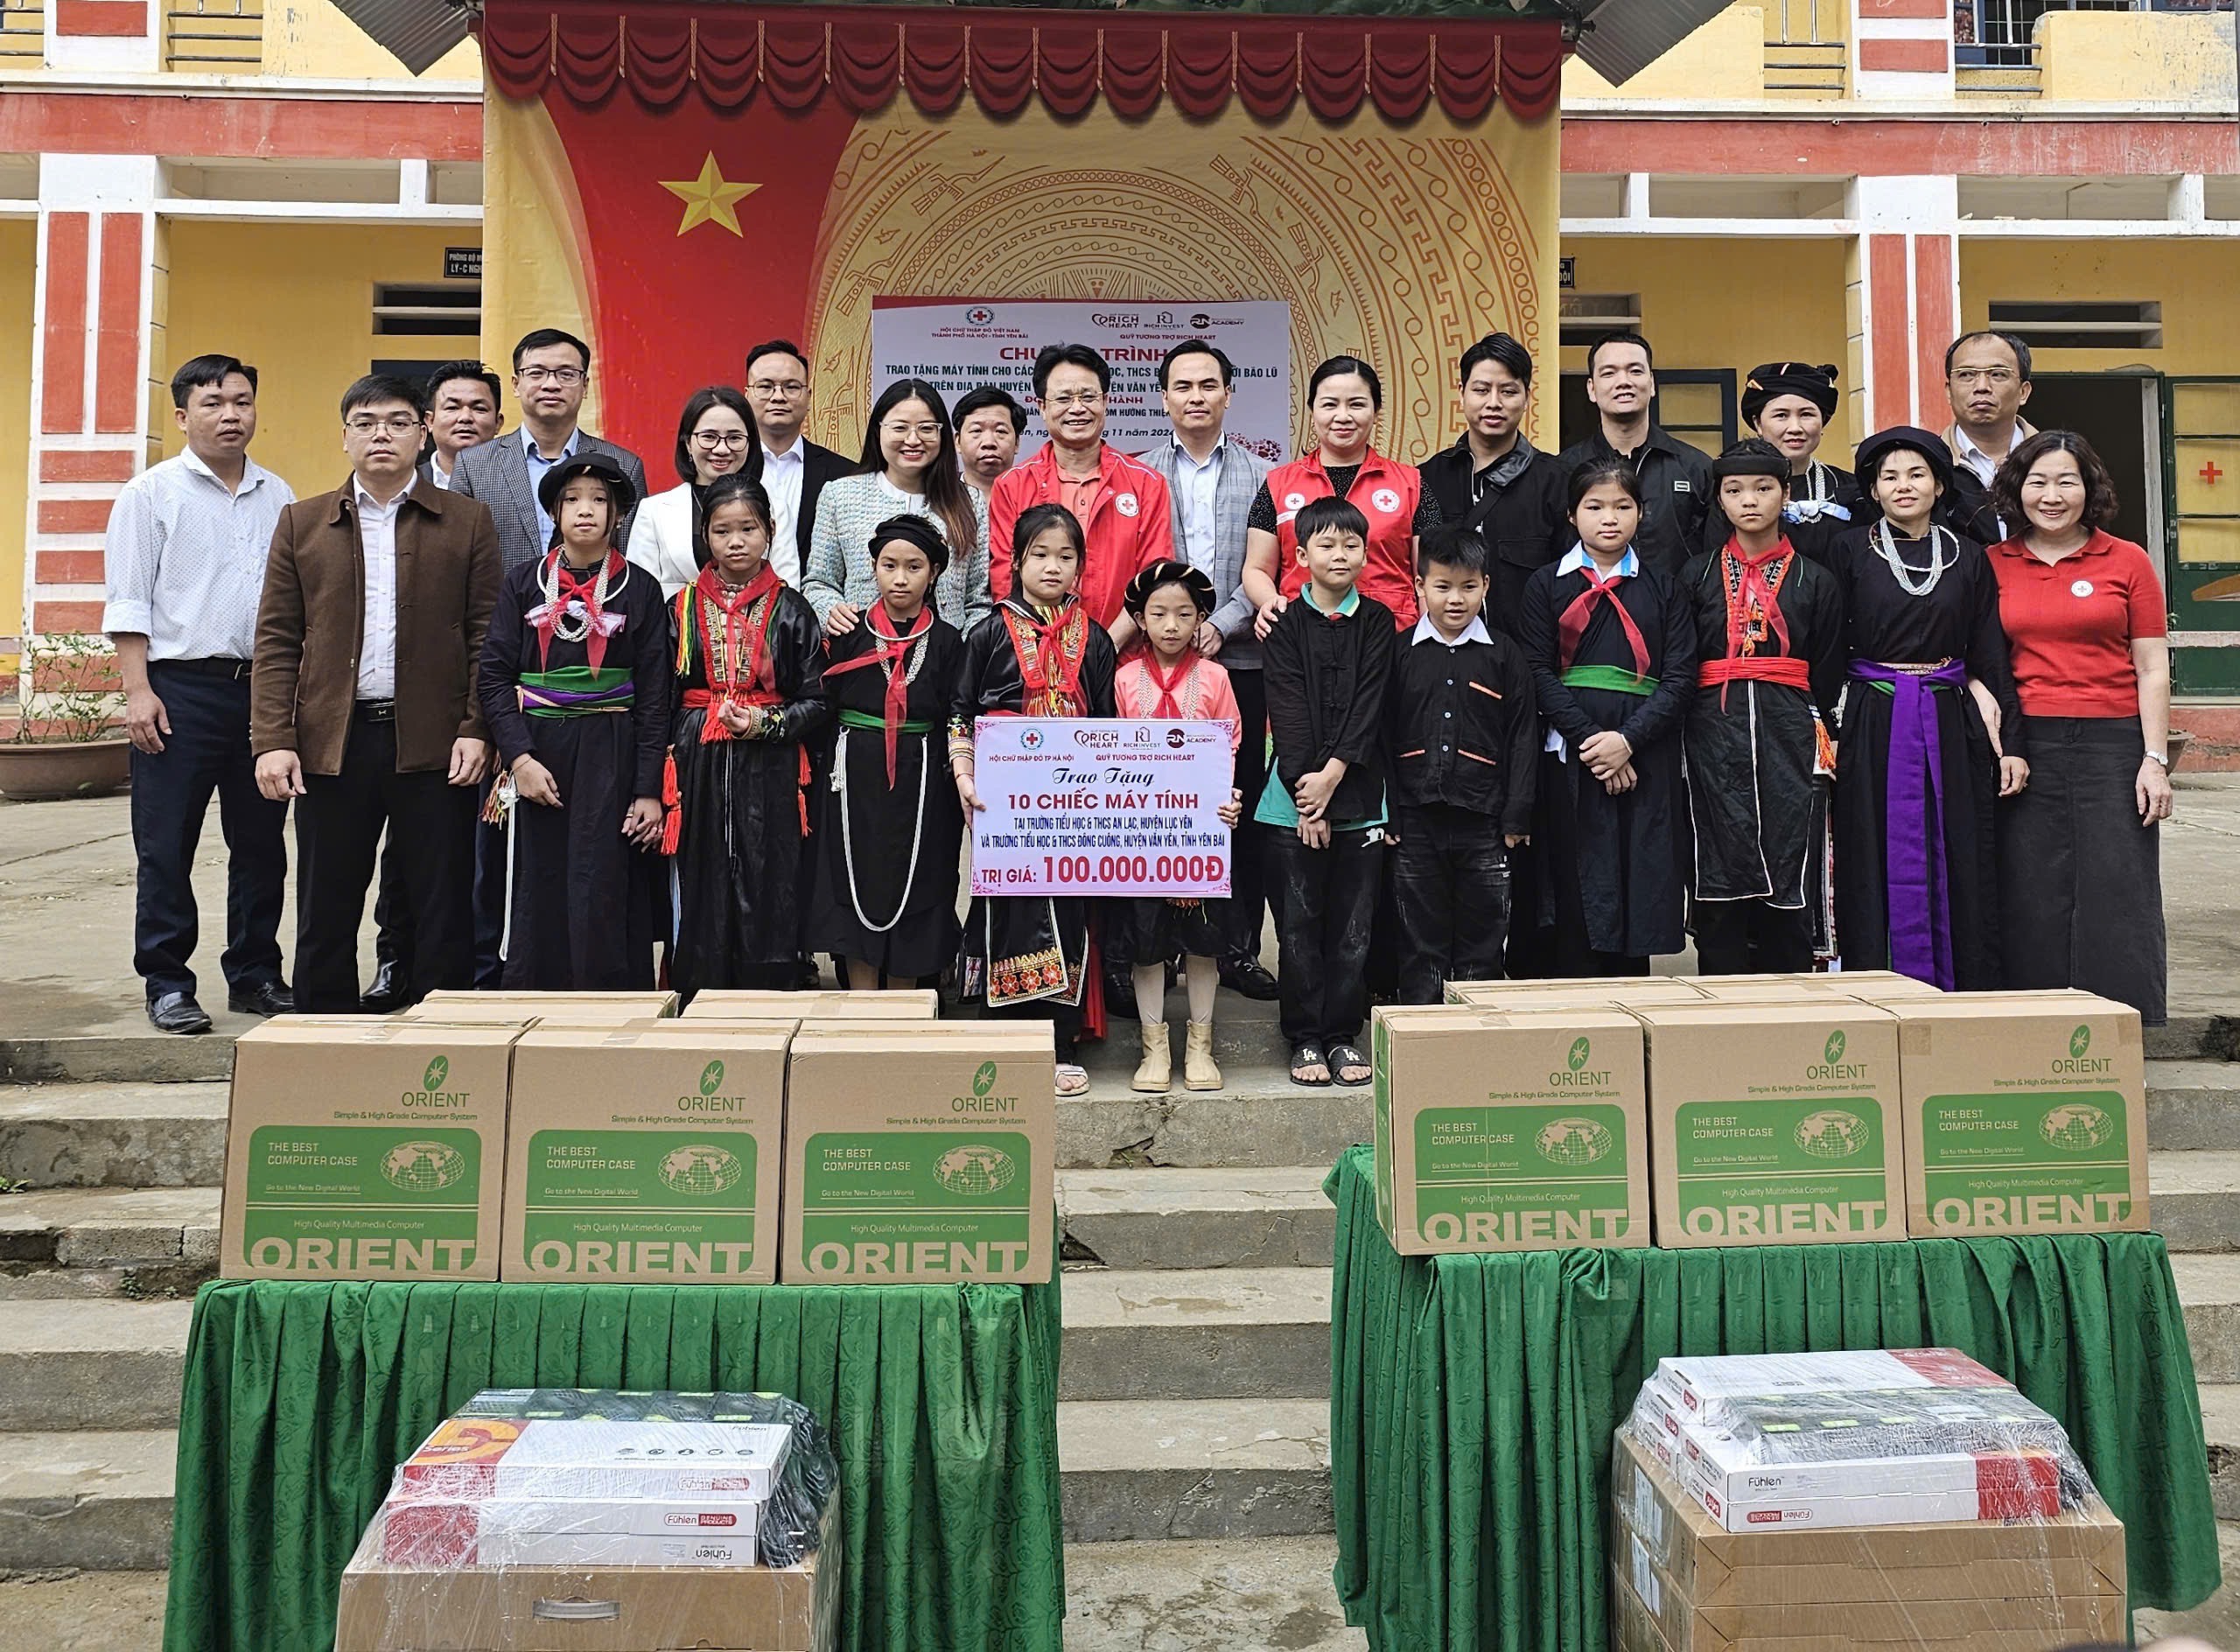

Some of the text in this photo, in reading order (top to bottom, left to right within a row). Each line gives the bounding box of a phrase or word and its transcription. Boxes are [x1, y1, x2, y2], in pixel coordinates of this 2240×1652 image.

[1100, 345, 1168, 361] TRÌNH
[886, 365, 910, 374] TRAO
[914, 364, 939, 377] TẶNG
[942, 364, 963, 375] MÁY
[966, 364, 989, 375] TÍNH
[991, 366, 1012, 375] CHO
[1015, 364, 1034, 376] CÁC
[1127, 367, 1152, 377] THCS
[1244, 366, 1264, 378] BÃO
[1266, 366, 1278, 378] LŨ
[956, 381, 973, 393] ĐỊA
[999, 381, 1031, 394] HUYỆN
[1127, 382, 1146, 392] VĂN
[1109, 395, 1143, 404] HÀNH
[1090, 732, 1119, 741] RICH
[1053, 767, 1154, 787] Trao Tặng
[1008, 787, 1199, 809] 10 CHIẾC MÁY TÍNH
[1014, 817, 1026, 832] TẠI
[1027, 815, 1054, 830] TRƯỜNG
[1073, 816, 1086, 831] HỌC
[1087, 817, 1092, 830] &
[1094, 817, 1111, 830] THCS
[1113, 817, 1123, 830] AN
[1140, 815, 1164, 831] HUYỆN
[1165, 816, 1178, 831] LỤC
[1179, 815, 1193, 830] YÊN
[981, 833, 990, 847] VÀ
[992, 833, 1018, 848] TRƯỜNG
[1037, 835, 1050, 850] HỌC
[1052, 836, 1057, 847] &
[1058, 836, 1076, 847] THCS
[1124, 832, 1147, 850] HUYỆN
[1198, 832, 1212, 847] YÊN
[1214, 832, 1225, 847] BÁI
[981, 855, 1224, 887] TRỊ GIÁ: 100.000.000Đ
[1302, 1047, 1318, 1062] LA
[1342, 1047, 1361, 1062] LA
[1806, 1063, 1867, 1080] ORIENT
[2051, 1058, 2112, 1074] ORIENT
[1549, 1071, 1612, 1086] ORIENT
[402, 1091, 471, 1108] ORIENT
[677, 1096, 746, 1112] ORIENT
[951, 1097, 1018, 1112] ORIENT
[1938, 1109, 1983, 1119] THE BEST
[1938, 1120, 2019, 1131] COMPUTER CASE
[268, 1142, 319, 1152] THE BEST
[823, 1149, 872, 1158] THE BEST
[268, 1155, 358, 1166] COMPUTER CASE
[822, 1161, 911, 1171] COMPUTER CASE
[1932, 1193, 2131, 1227] ORIENT
[1423, 1208, 1628, 1243] ORIENT
[1686, 1200, 1886, 1236] ORIENT
[850, 1224, 869, 1233] High
[870, 1224, 897, 1234] Quality
[941, 1224, 978, 1234] Computer
[250, 1236, 476, 1271] ORIENT
[530, 1240, 752, 1274] ORIENT
[808, 1242, 1028, 1274] ORIENT
[1748, 1476, 1782, 1487] Fühlen
[668, 1515, 697, 1524] Fühlen
[1783, 1510, 1810, 1519] Fühlen
[696, 1550, 732, 1560] Fühlen
